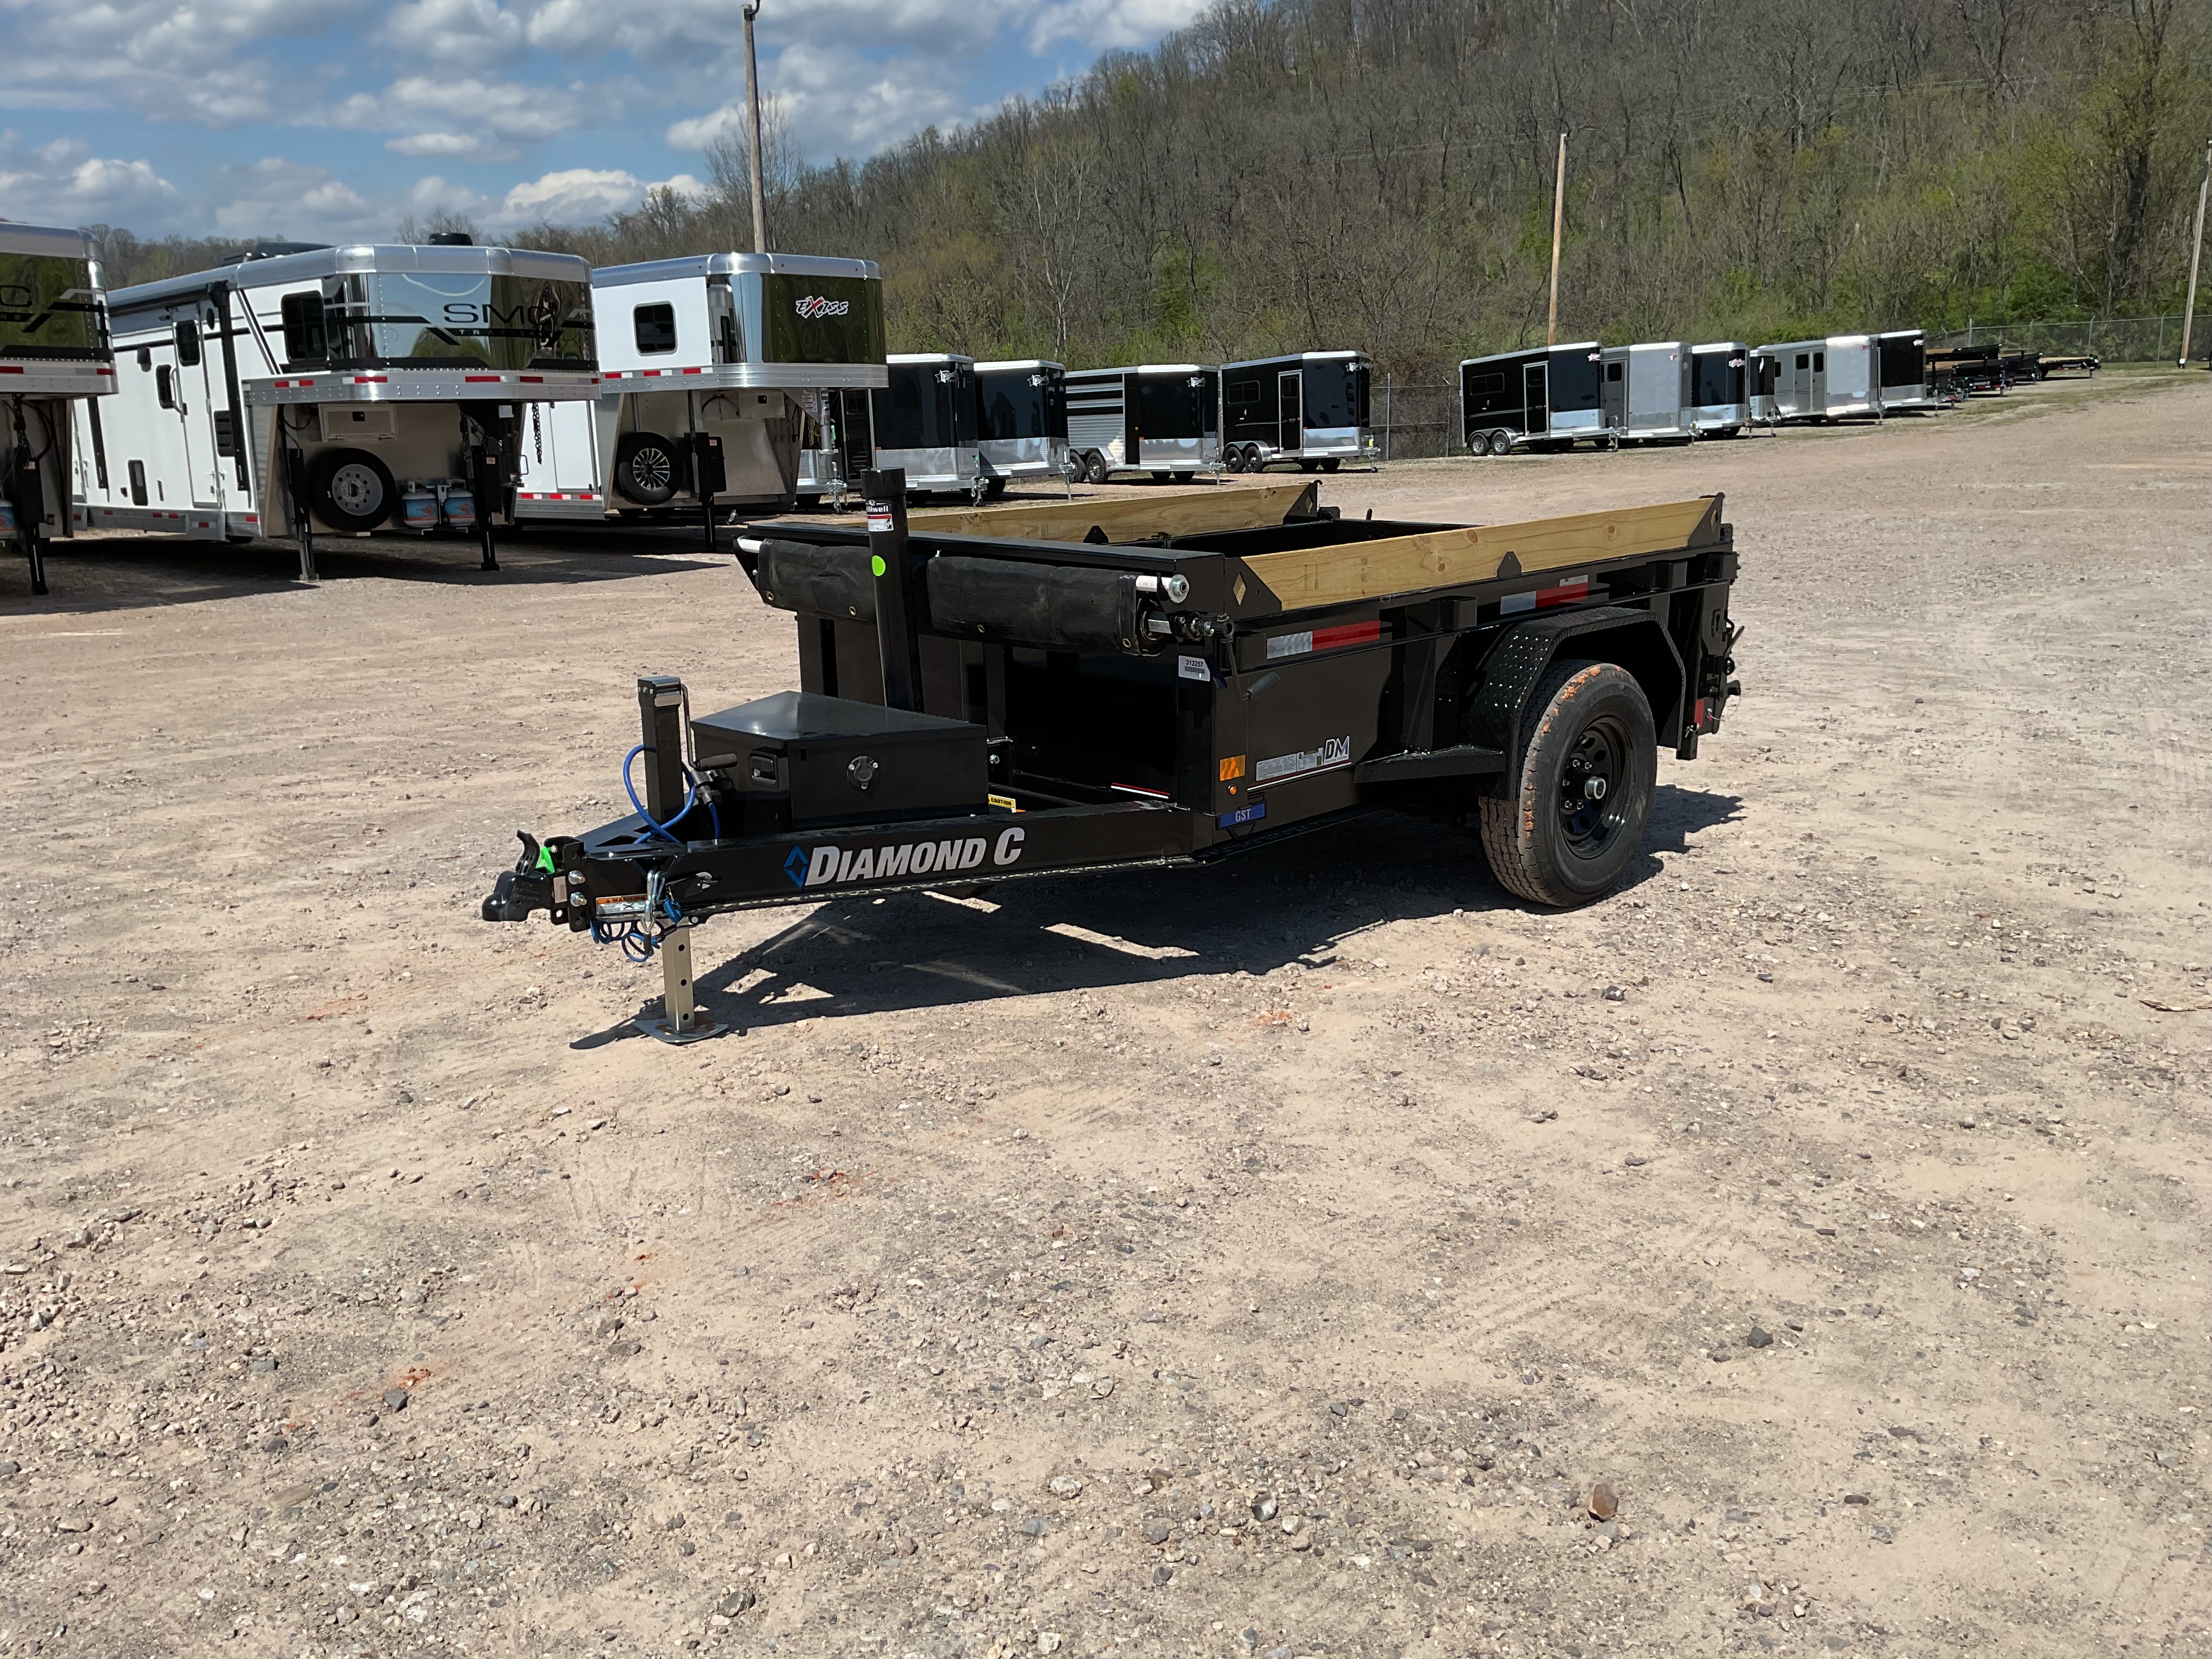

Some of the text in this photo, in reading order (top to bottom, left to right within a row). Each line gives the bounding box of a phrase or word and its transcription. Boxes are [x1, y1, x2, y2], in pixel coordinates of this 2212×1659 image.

[796, 296, 849, 318] EXISS
[1325, 736, 1349, 759] DM
[991, 798, 1011, 806] CAUTION
[1235, 808, 1251, 822] GST
[805, 827, 1025, 886] DIAMOND C
